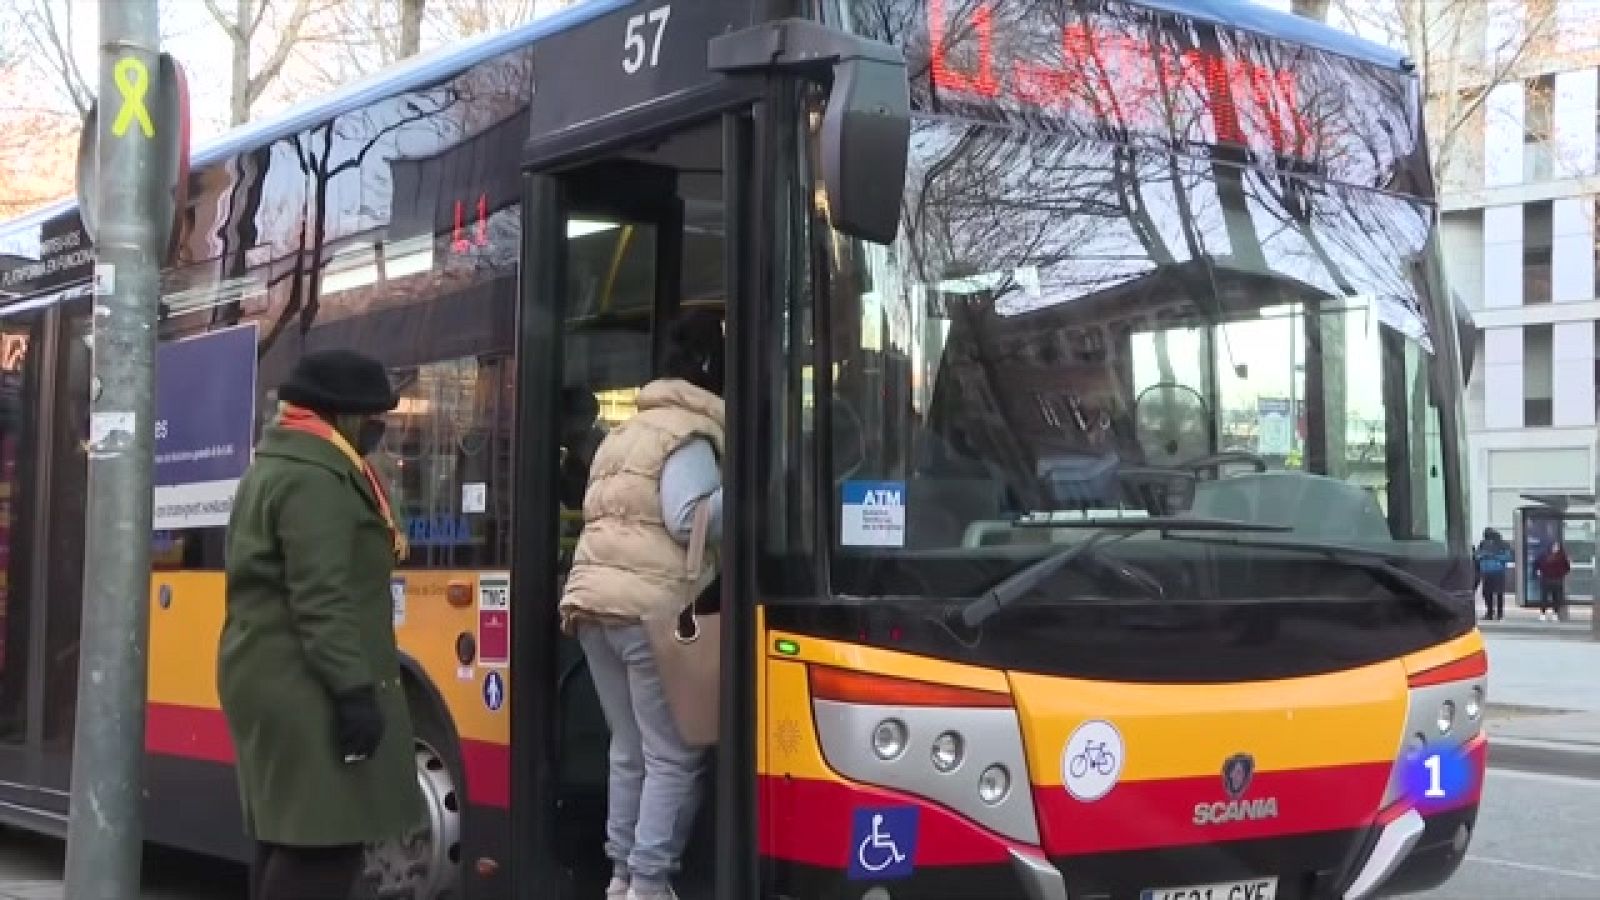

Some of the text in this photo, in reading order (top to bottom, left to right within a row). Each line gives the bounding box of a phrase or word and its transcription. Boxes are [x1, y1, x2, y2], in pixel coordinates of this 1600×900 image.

[622, 4, 671, 74] 57
[452, 195, 488, 254] L1
[862, 489, 901, 507] ATM
[1192, 797, 1278, 825] SCANIA
